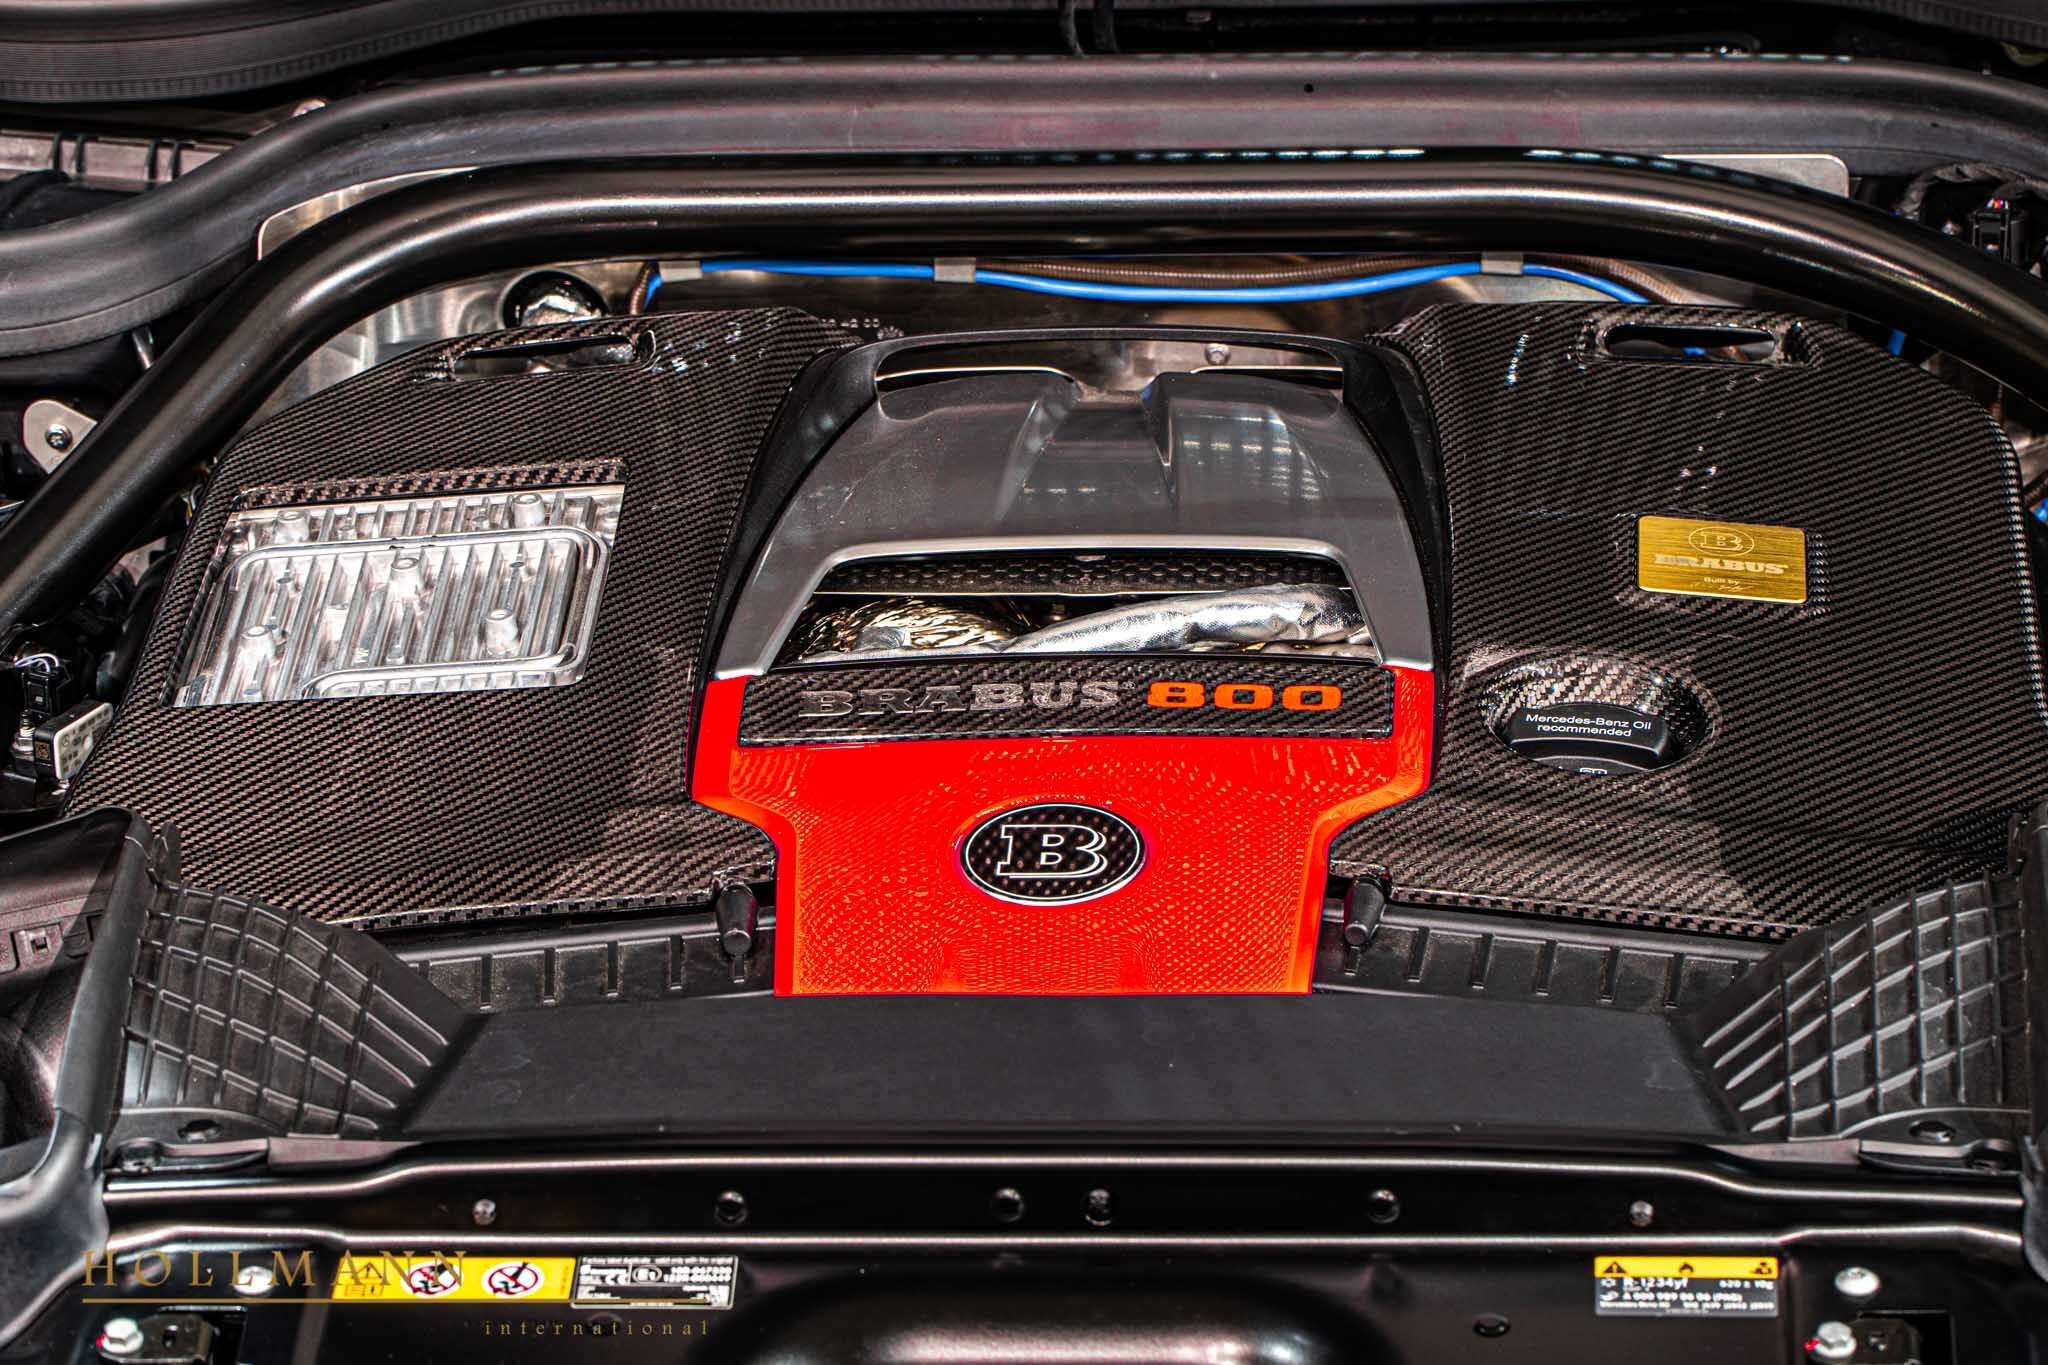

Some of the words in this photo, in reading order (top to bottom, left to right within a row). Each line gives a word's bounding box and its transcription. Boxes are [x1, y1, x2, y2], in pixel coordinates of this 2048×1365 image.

[1146, 681, 1343, 712] 800
[1525, 713, 1629, 728] Mercedes-Benz
[1632, 720, 1652, 730] Oil
[1537, 723, 1632, 737] recommended
[1623, 1277, 1689, 1290] R-1234yf
